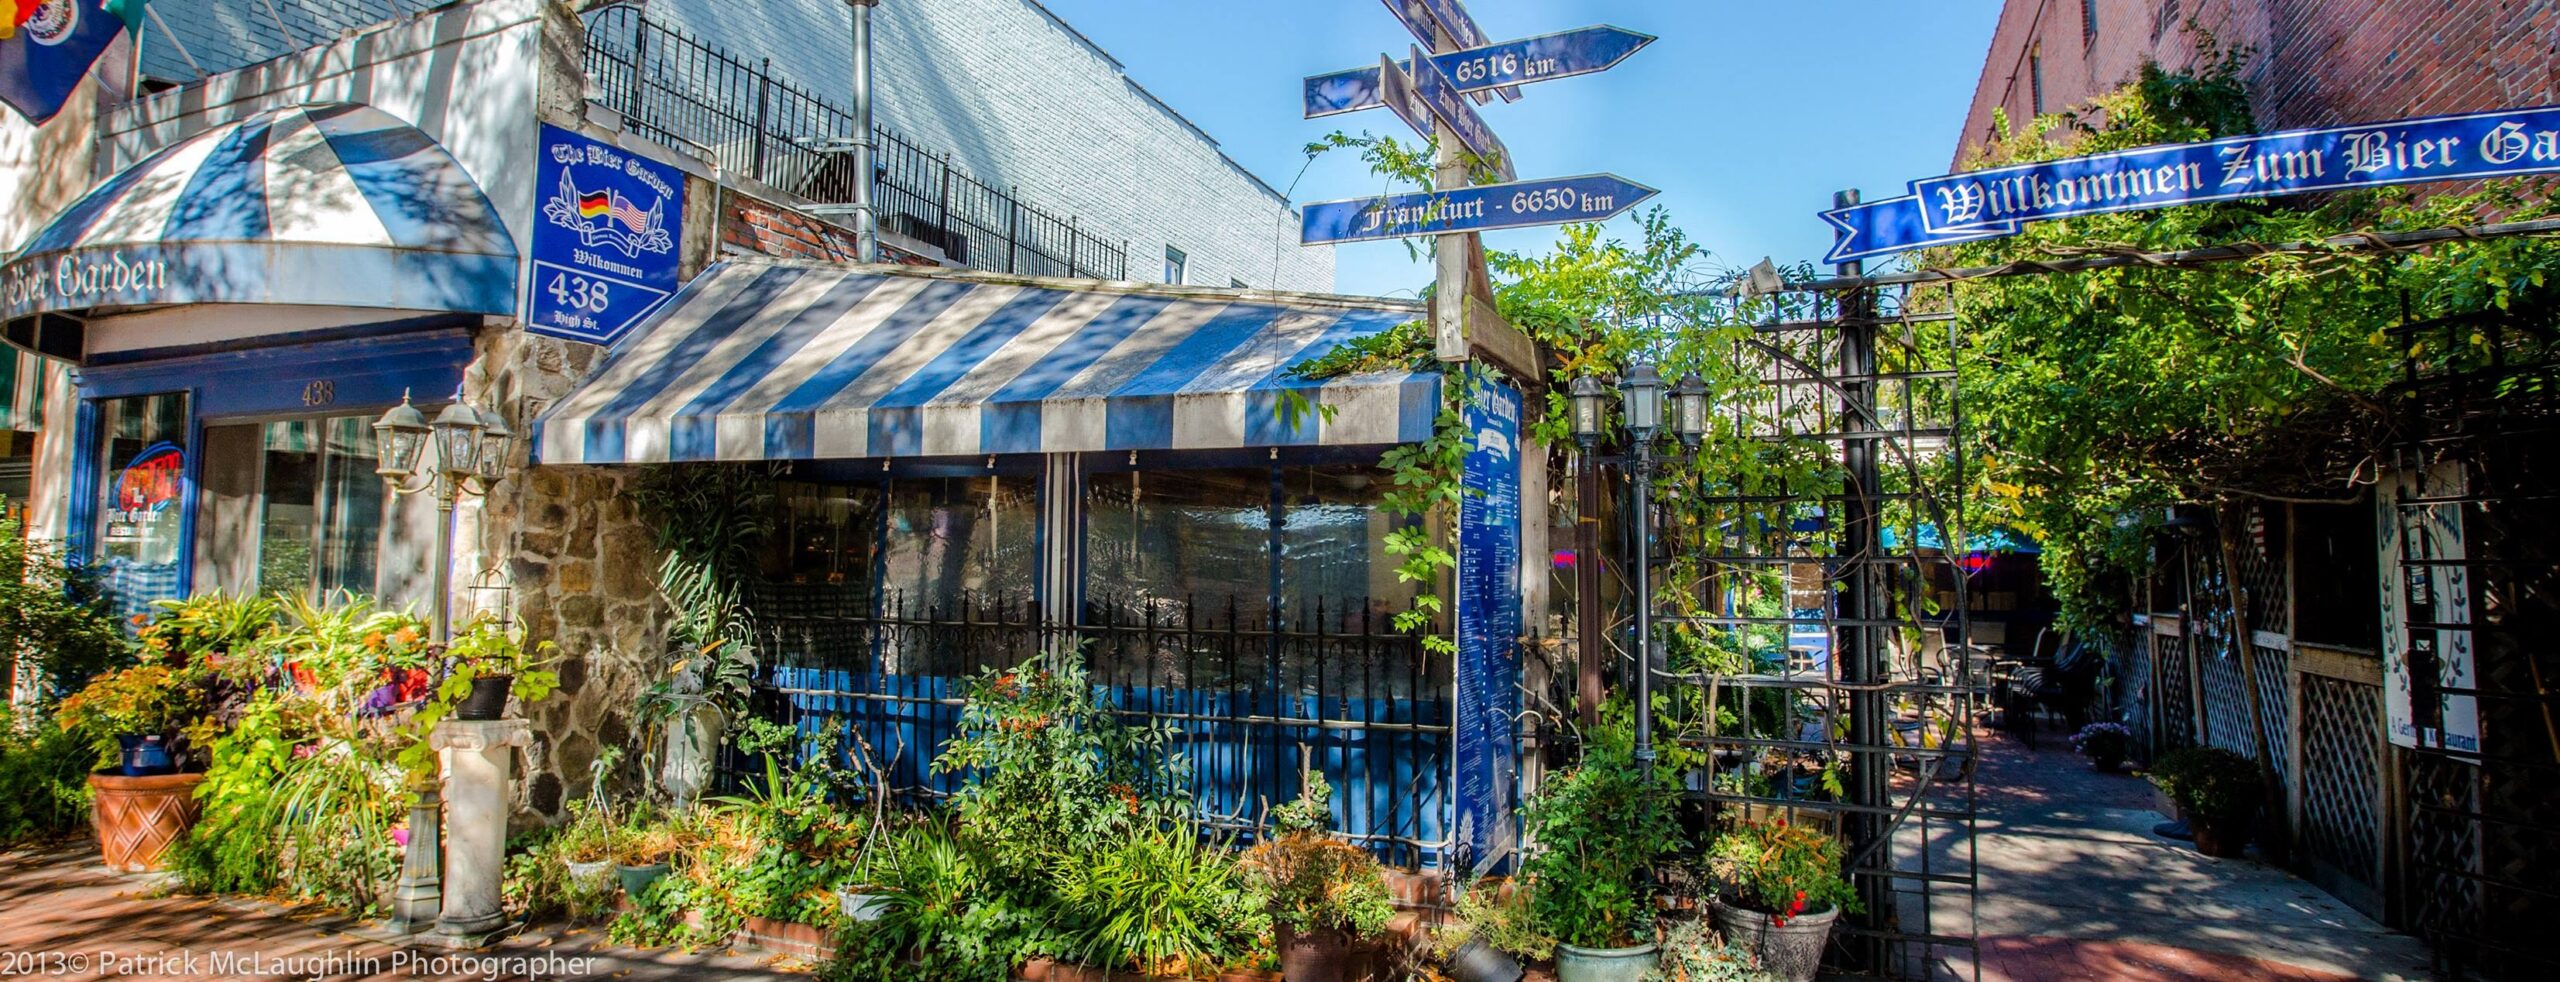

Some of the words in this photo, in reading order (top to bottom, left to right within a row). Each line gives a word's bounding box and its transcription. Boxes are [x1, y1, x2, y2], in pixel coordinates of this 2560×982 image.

[1456, 53, 1518, 82] 6516
[1523, 57, 1557, 77] km
[1439, 81, 1456, 119] Zum
[552, 143, 585, 165] The
[587, 144, 623, 171] Bier
[625, 158, 675, 200] Garden
[1936, 160, 2204, 225] Willkommen
[2218, 144, 2326, 188] Zum
[2341, 130, 2461, 181] Bier
[1362, 196, 1484, 232] Frankfurt
[1511, 187, 1576, 214] 6650
[1581, 193, 1614, 212] km
[10, 262, 48, 306] Bier
[56, 250, 167, 297] Garden
[573, 248, 644, 280] Wilkommen
[548, 272, 609, 313] 438
[554, 310, 581, 328] High
[582, 316, 600, 331] St.
[302, 380, 334, 406] 438
